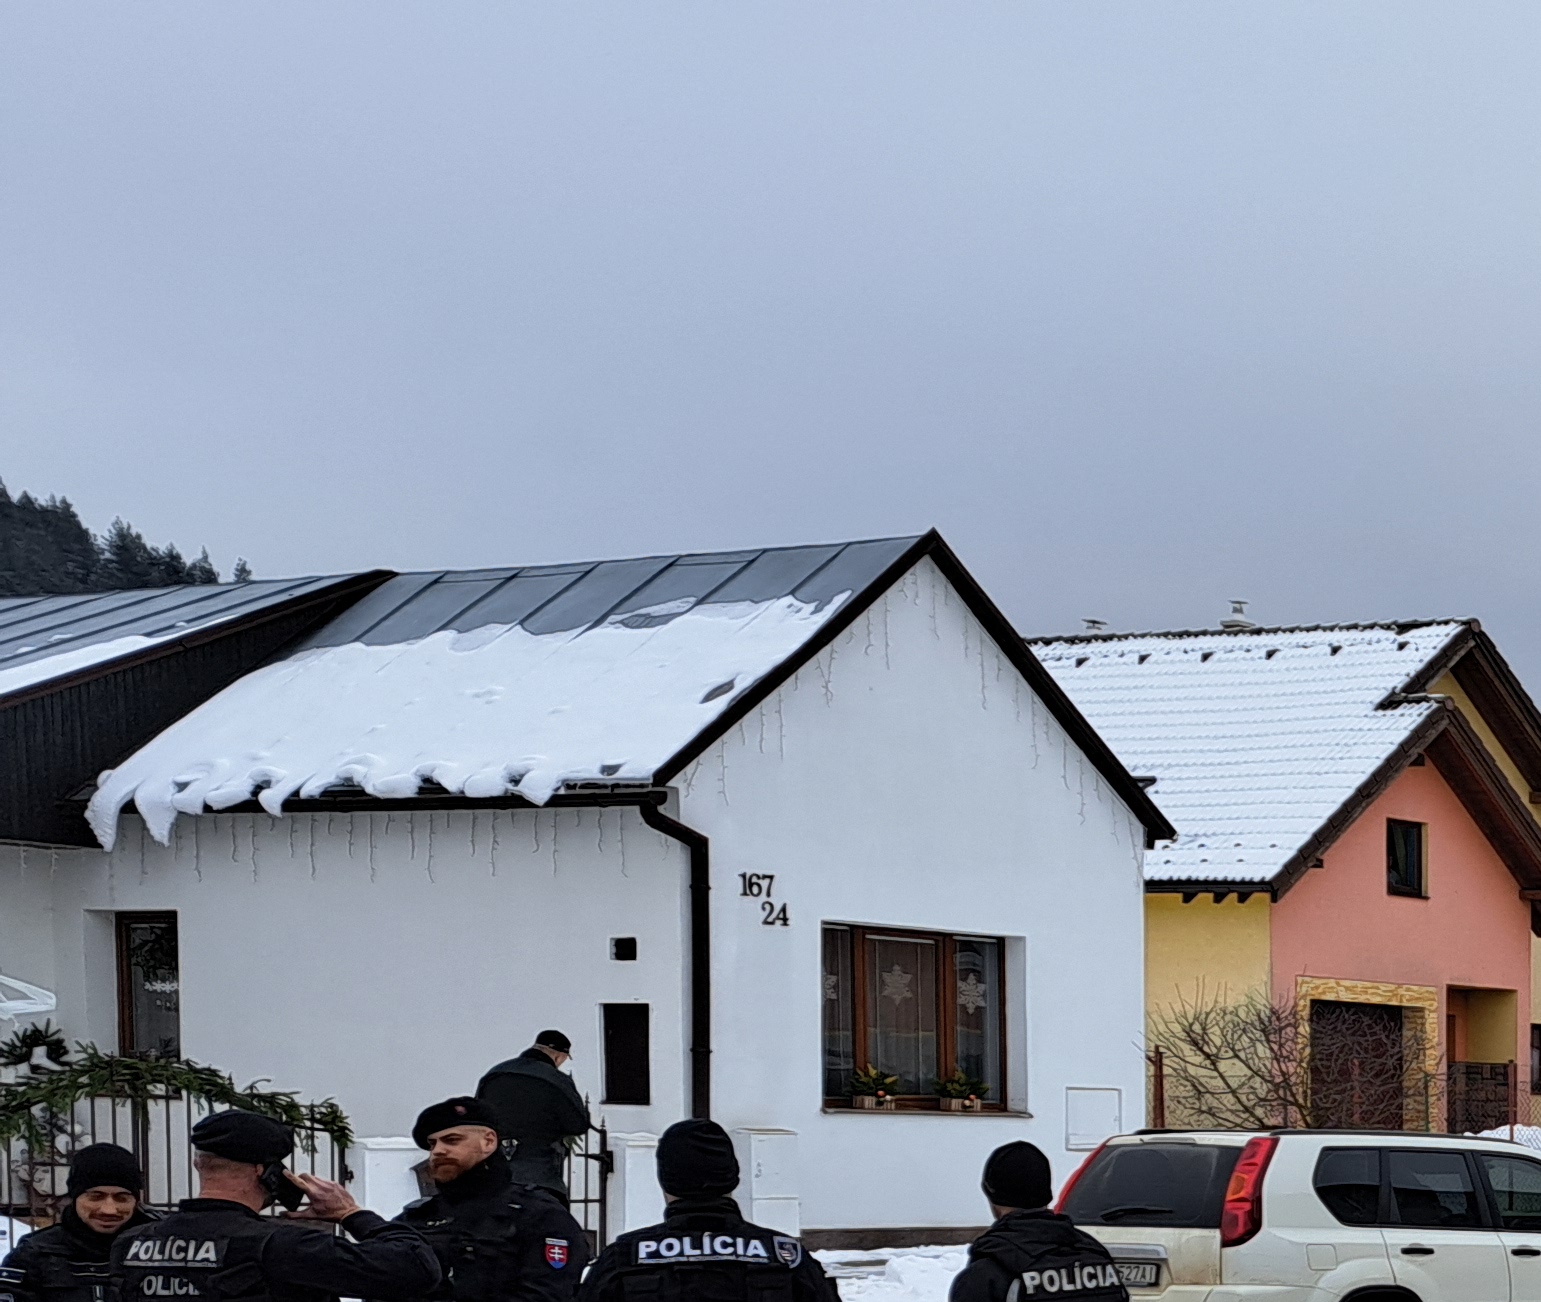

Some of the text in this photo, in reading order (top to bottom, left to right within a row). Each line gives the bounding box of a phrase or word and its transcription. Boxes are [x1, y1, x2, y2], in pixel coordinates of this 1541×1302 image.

[738, 872, 774, 898] 167
[761, 901, 790, 926] 24
[126, 1235, 217, 1262] POLÍCIA
[638, 1231, 770, 1259] POLÍCIA
[1022, 1261, 1120, 1295] POLÍCIA
